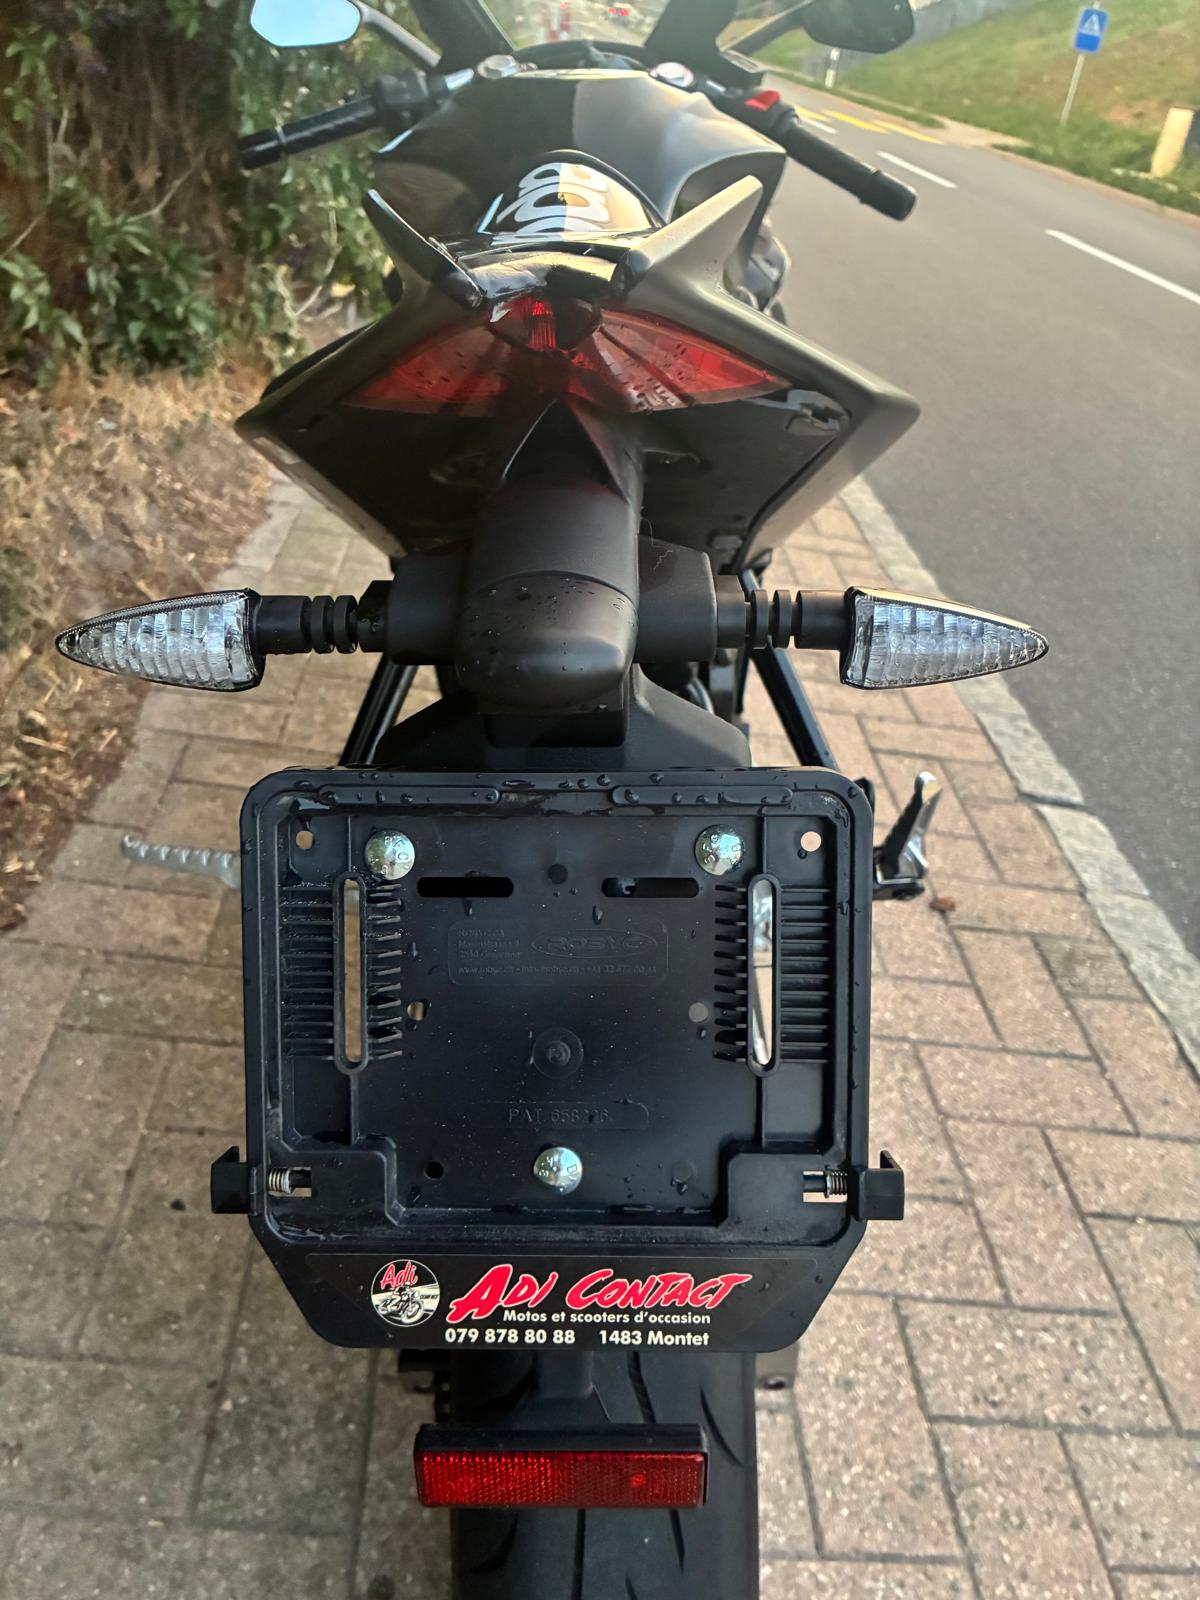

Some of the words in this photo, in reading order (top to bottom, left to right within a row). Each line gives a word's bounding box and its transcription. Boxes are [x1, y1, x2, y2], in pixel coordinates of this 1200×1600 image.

[380, 1261, 418, 1291] Adi
[565, 1268, 752, 1310] CONTACT
[503, 1310, 547, 1322] Motos
[551, 1311, 565, 1322] et
[570, 1311, 630, 1323] scooters
[634, 1312, 711, 1324] d'occasion
[445, 1328, 479, 1343] 079
[484, 1329, 519, 1343] 878
[524, 1329, 547, 1344] 80
[552, 1329, 576, 1344] 88
[599, 1330, 642, 1345] 1483
[647, 1331, 709, 1345] Montet
